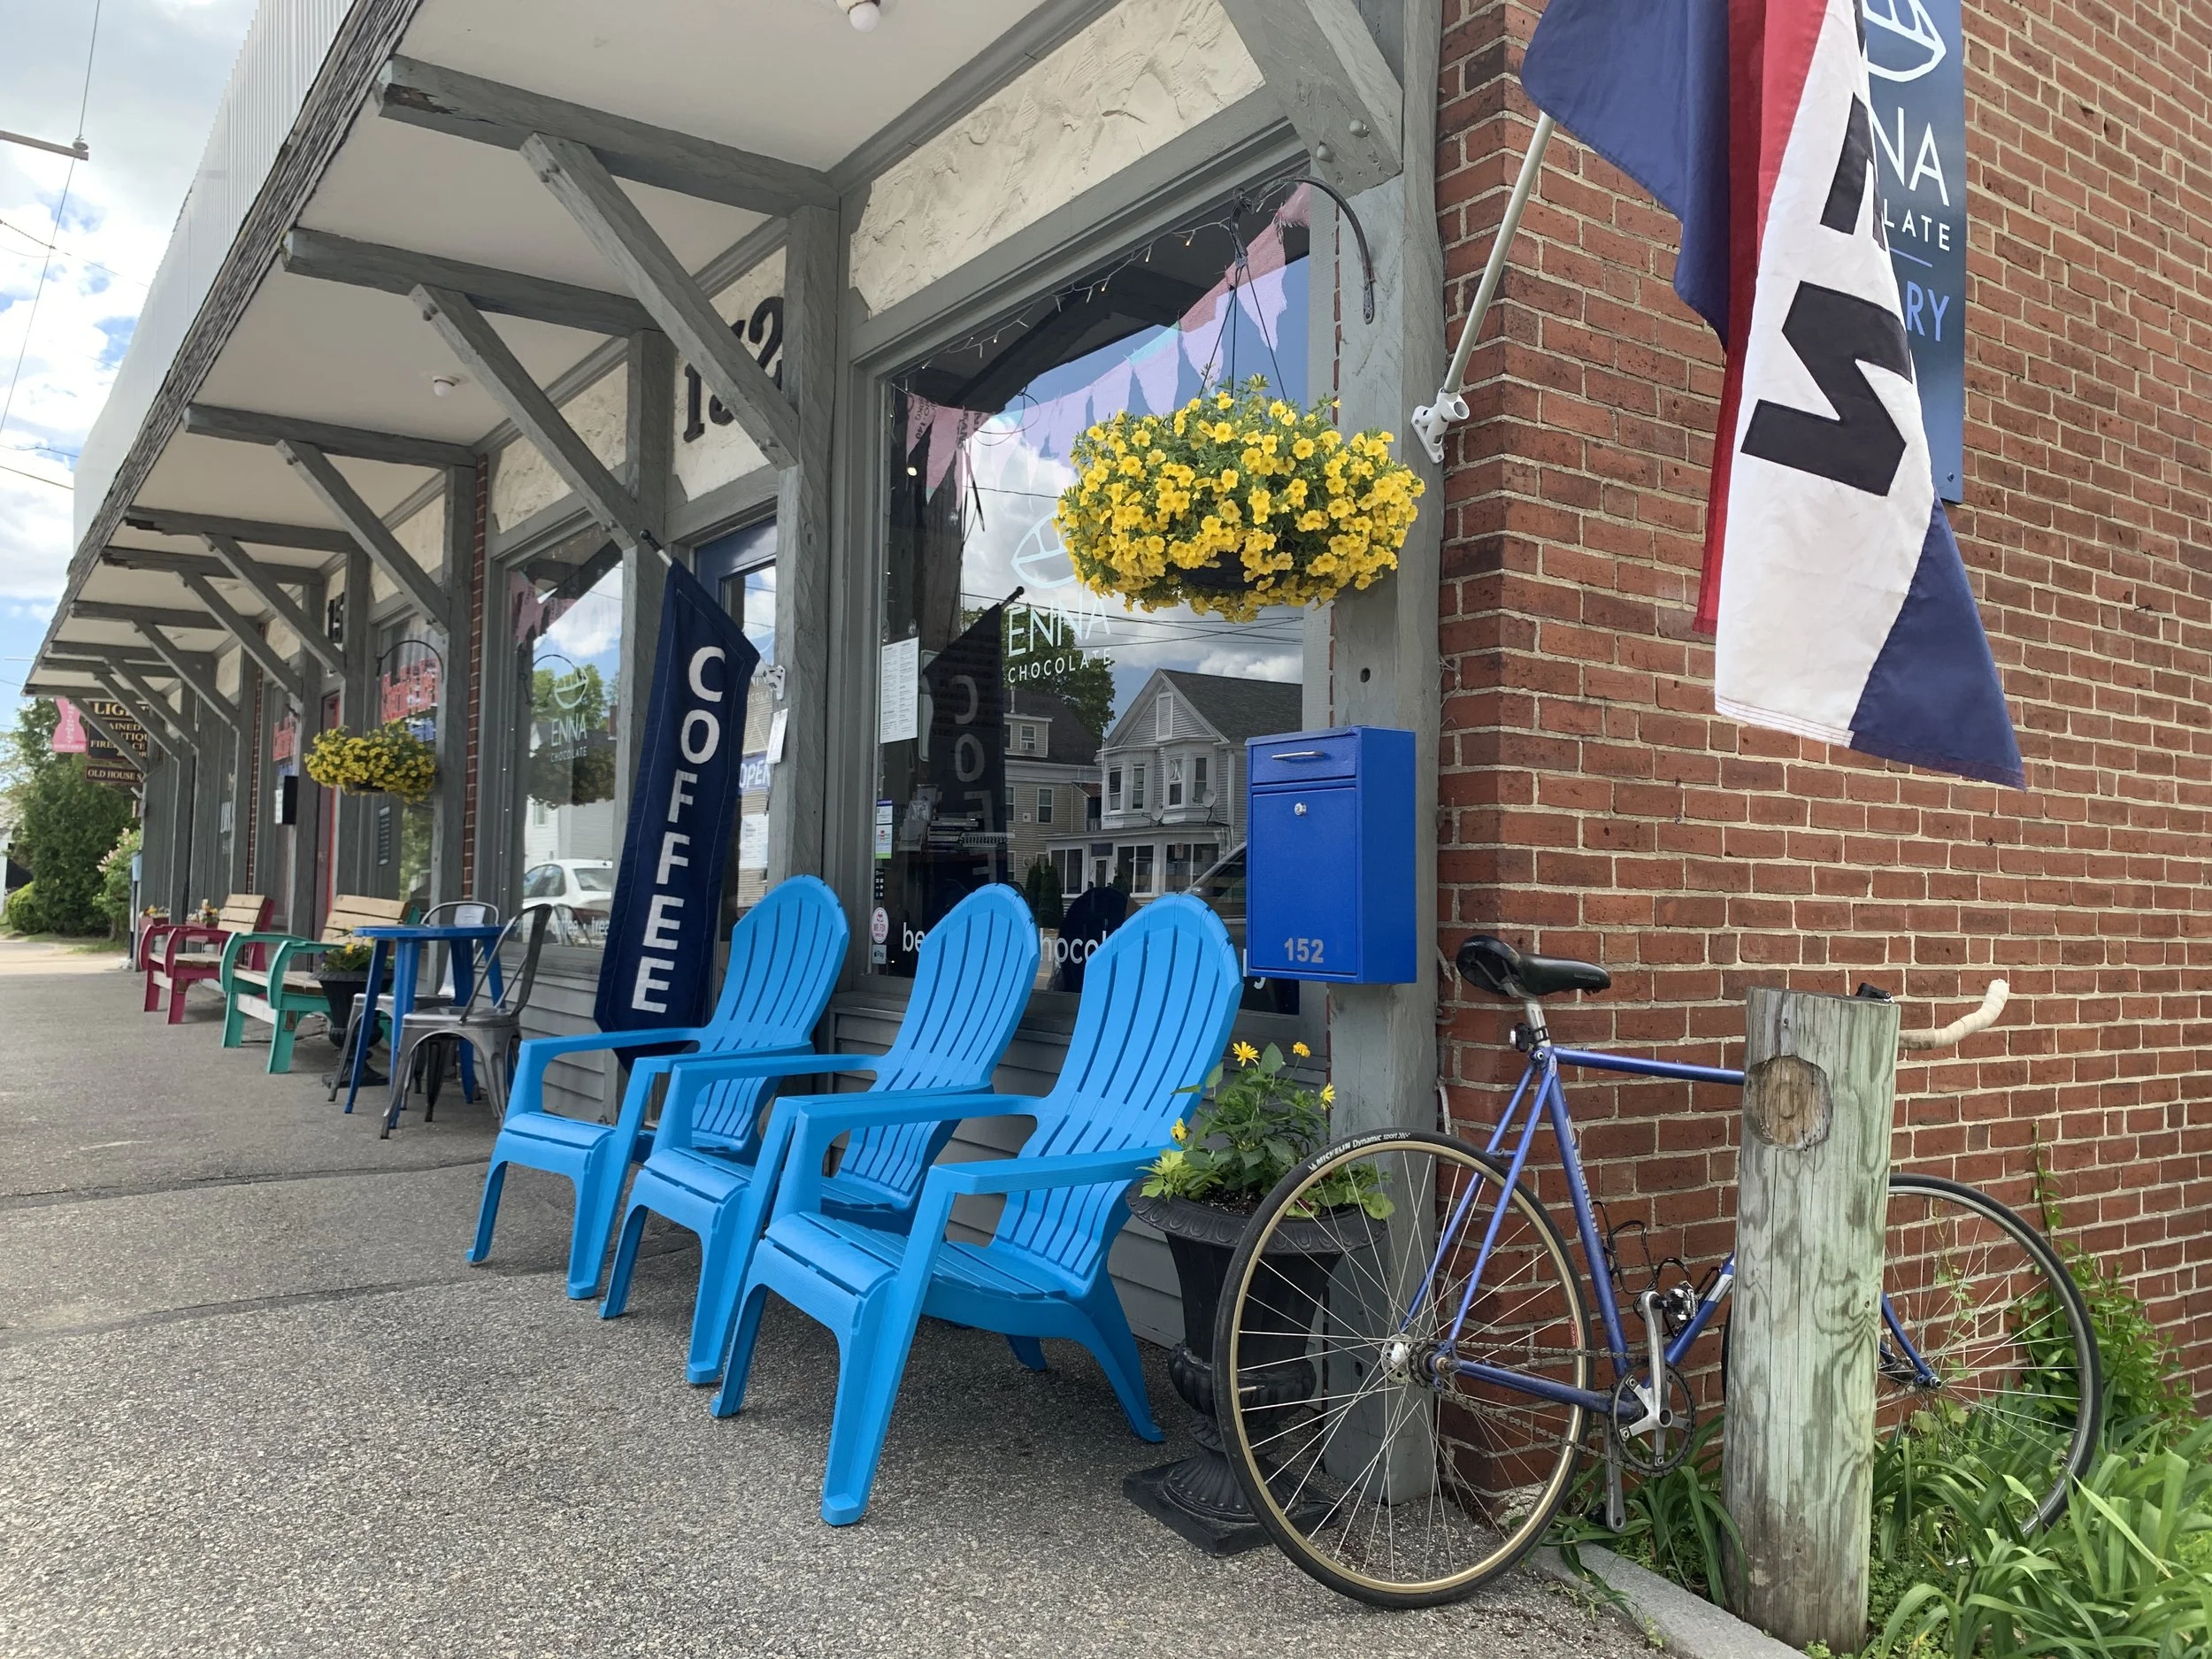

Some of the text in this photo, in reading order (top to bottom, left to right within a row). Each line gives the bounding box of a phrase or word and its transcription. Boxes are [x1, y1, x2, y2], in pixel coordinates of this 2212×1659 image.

[1870, 106, 1950, 207] NA
[1884, 198, 1951, 252] LATE
[1906, 280, 1950, 342] RY
[1009, 592, 1111, 657] ENNA
[1008, 647, 1111, 683] CHOCOLATE
[551, 712, 588, 747] ENNA
[550, 746, 588, 763] CHOCOLATE
[107, 771, 135, 780] HOUSE
[631, 646, 726, 1014] COFFEE
[1284, 937, 1325, 964] 152
[1315, 1132, 1398, 1166] MICHELIN Dynamic sport
